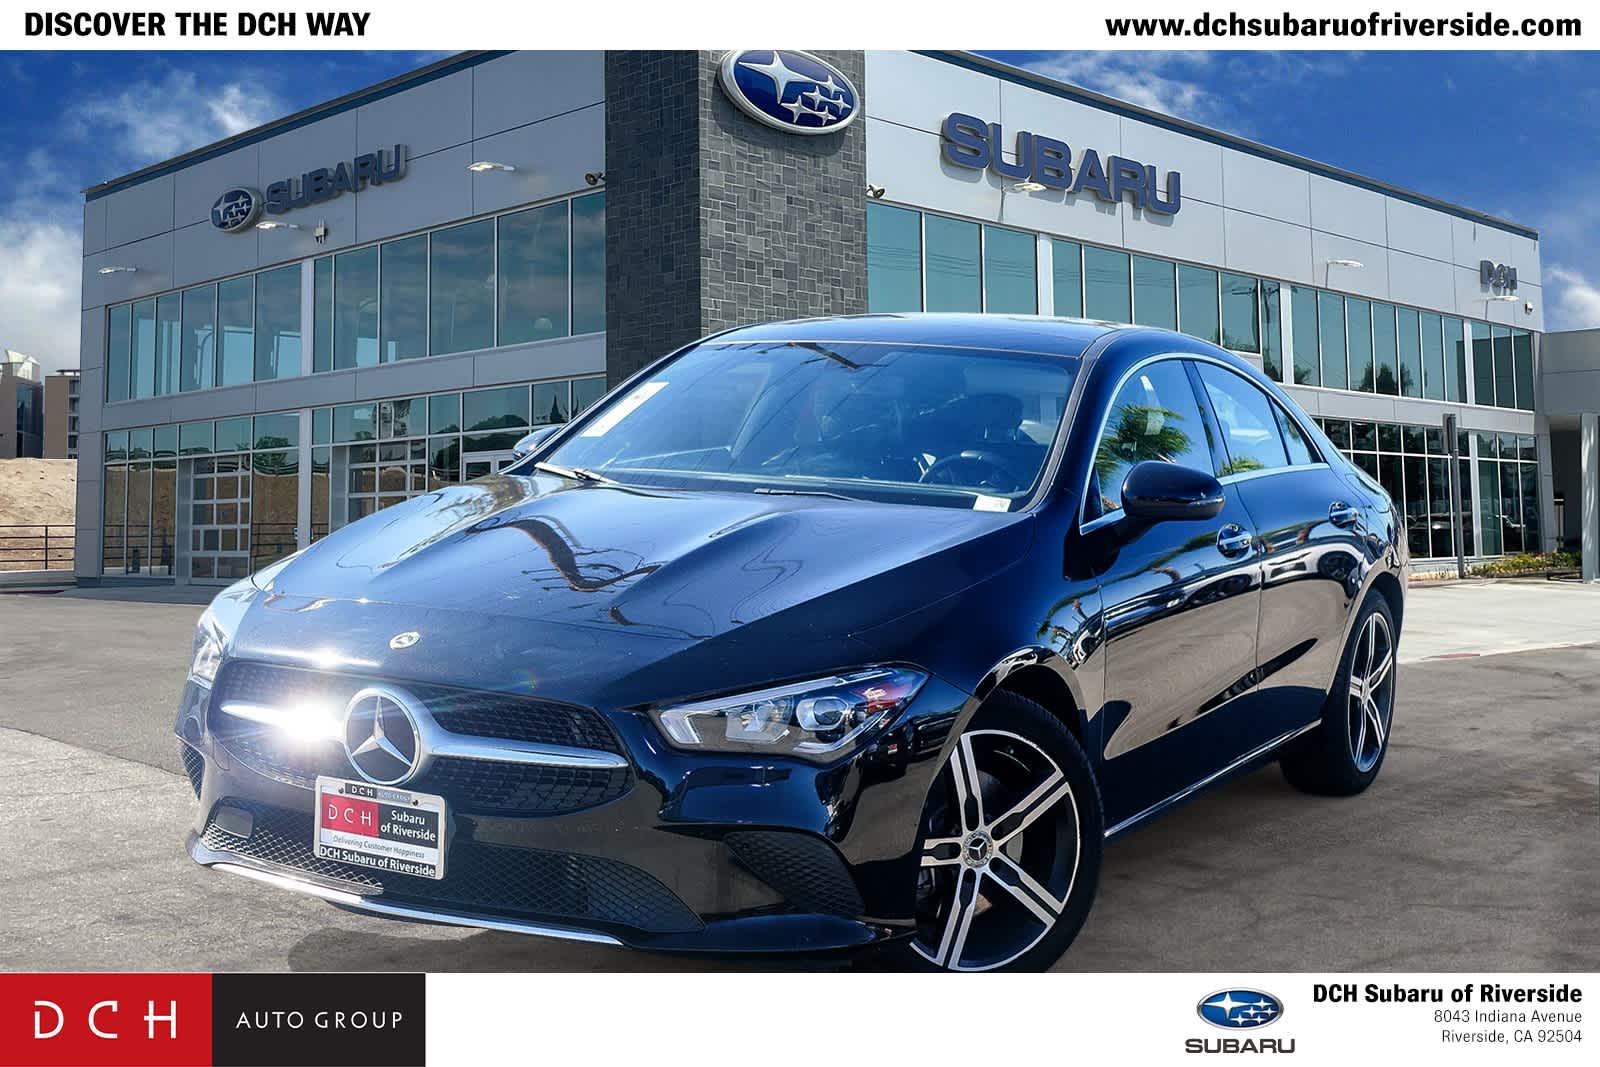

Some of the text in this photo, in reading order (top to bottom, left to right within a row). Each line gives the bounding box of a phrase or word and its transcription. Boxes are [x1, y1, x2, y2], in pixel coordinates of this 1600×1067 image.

[941, 112, 1181, 215] SUBARU
[266, 144, 407, 214] SUBARU
[328, 804, 371, 827] DCH
[391, 810, 425, 825] Subaru
[381, 823, 436, 841] of Riverside
[320, 845, 435, 876] DCH Subaru of Riverside
